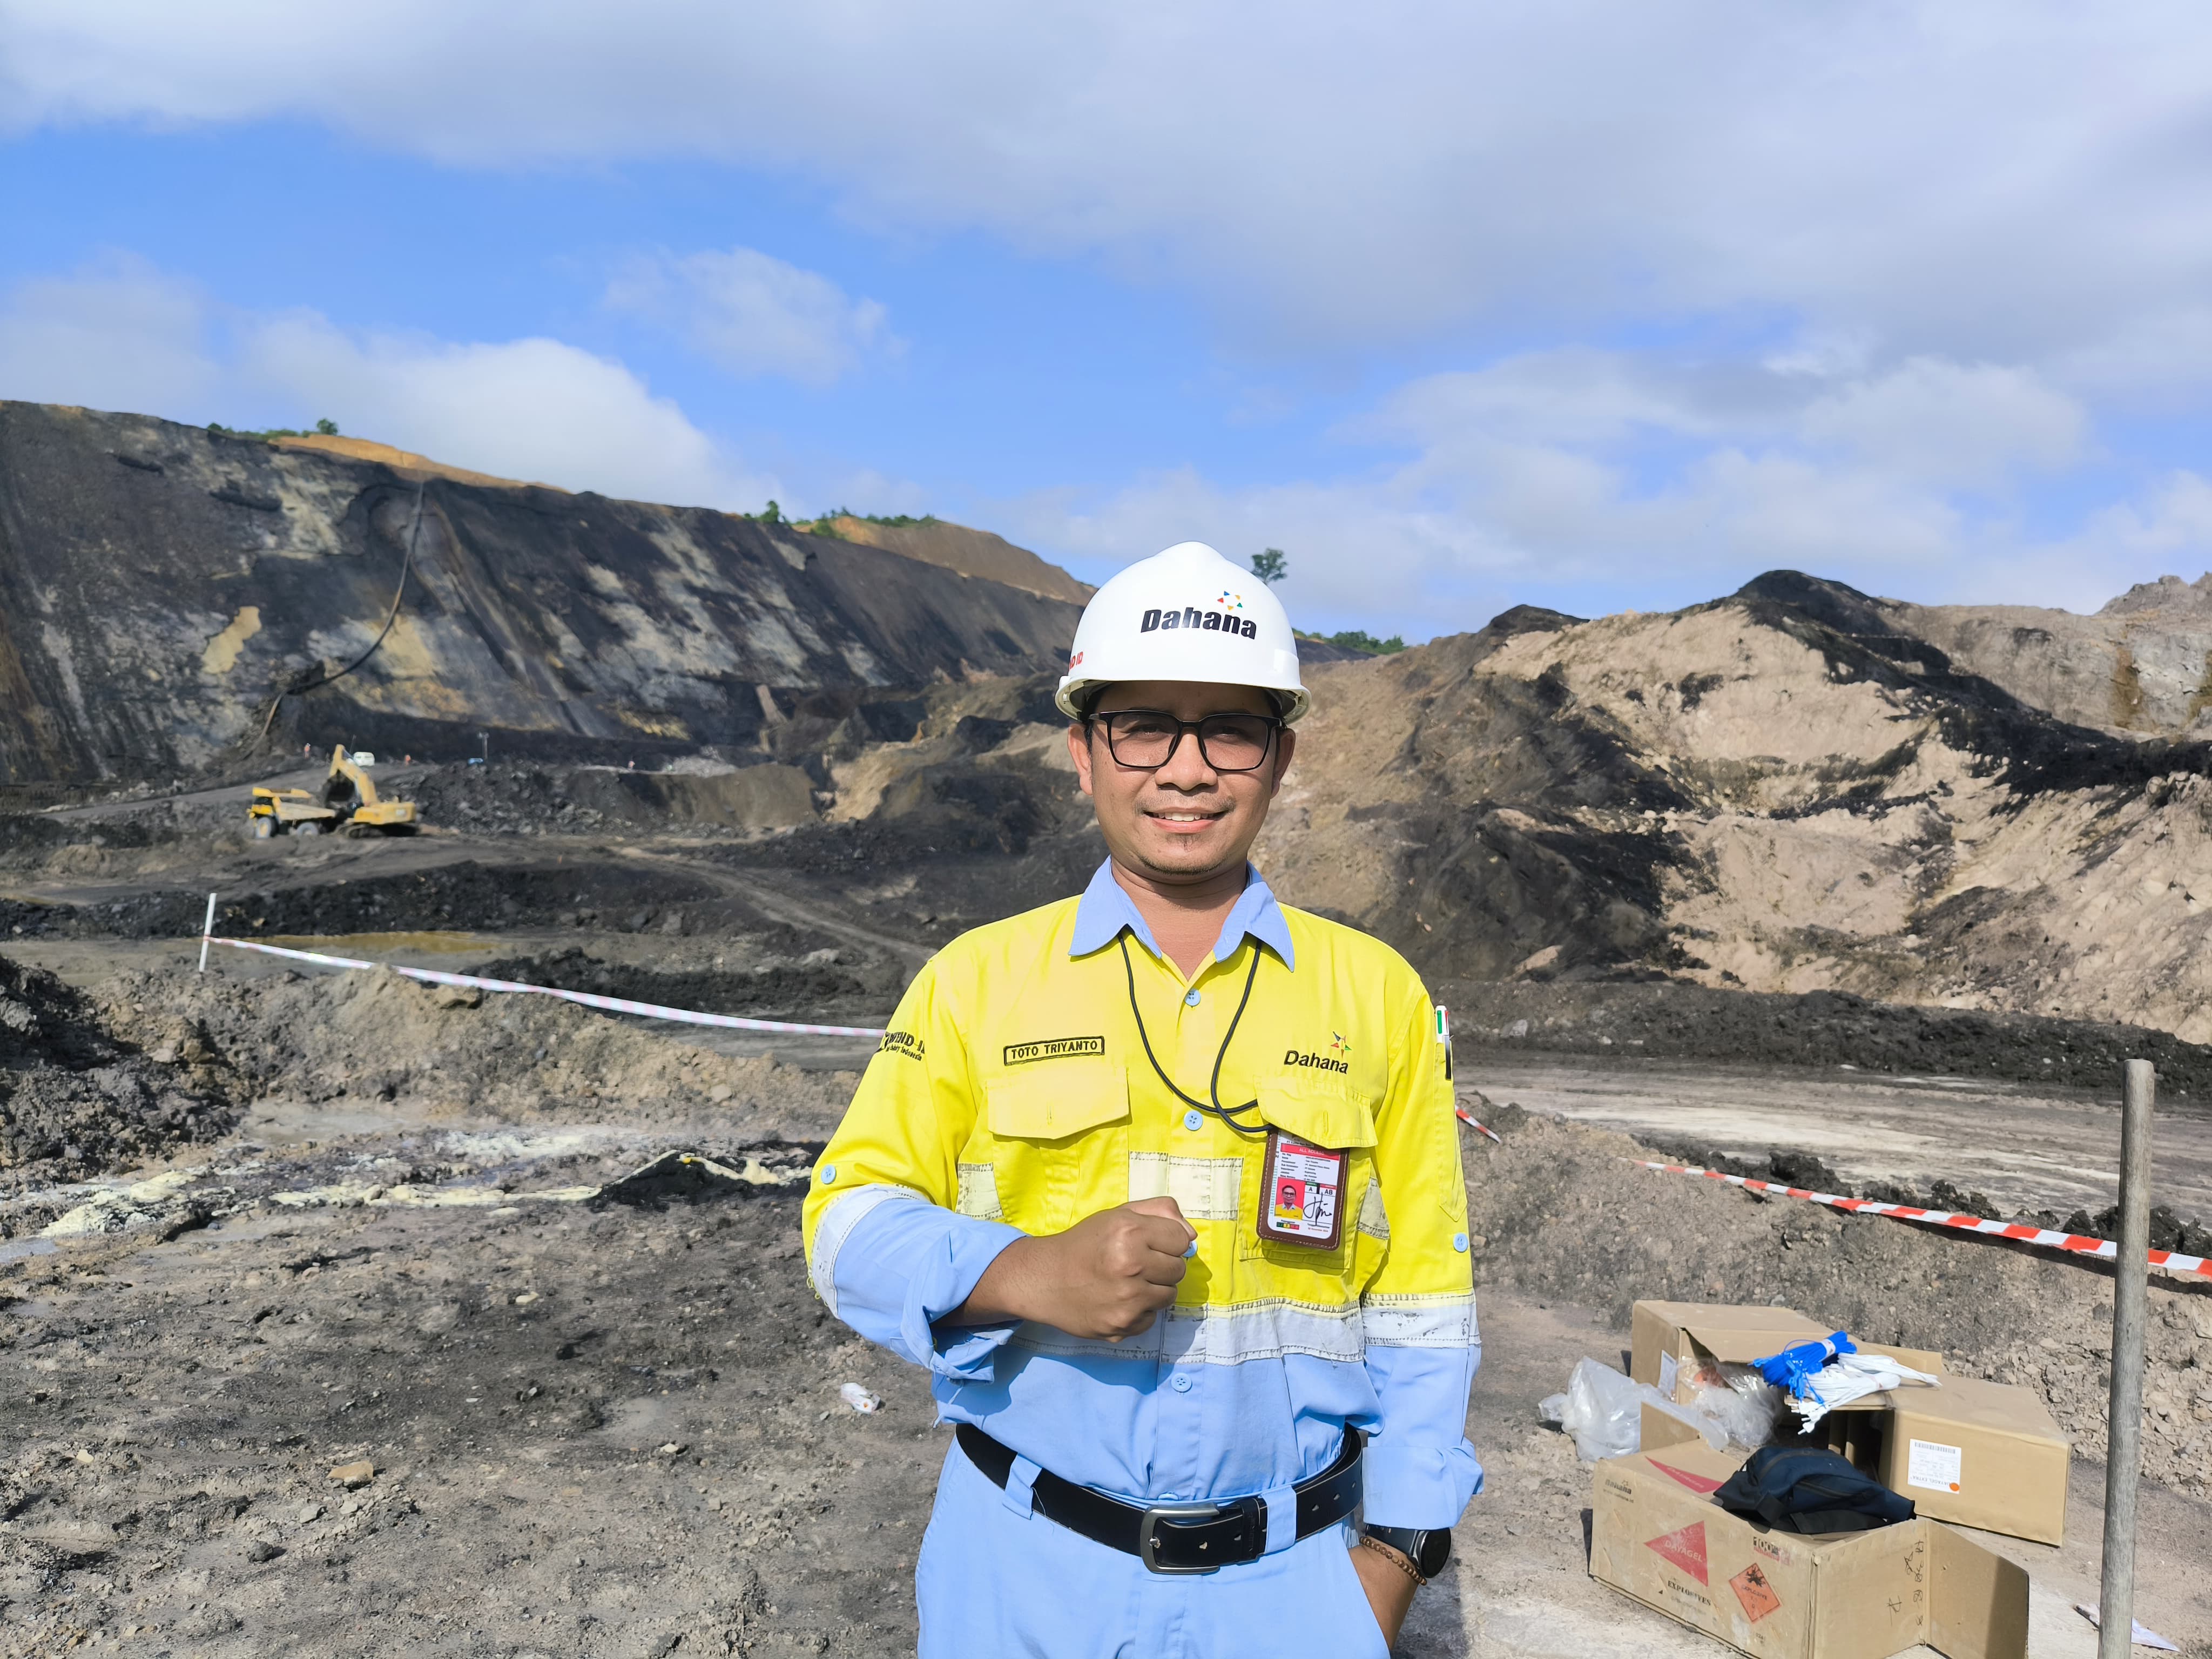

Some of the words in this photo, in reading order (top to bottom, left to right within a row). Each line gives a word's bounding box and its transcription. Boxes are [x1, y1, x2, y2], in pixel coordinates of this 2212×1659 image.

[1141, 607, 1257, 639] Dahana
[1011, 1046, 1038, 1059] TOTO
[1044, 1040, 1098, 1054] TRIYANTO
[1284, 1050, 1348, 1075] Dahana
[1665, 1540, 1703, 1562] DAYAGEL
[1668, 1580, 1711, 1606] EXPLOSIVES
